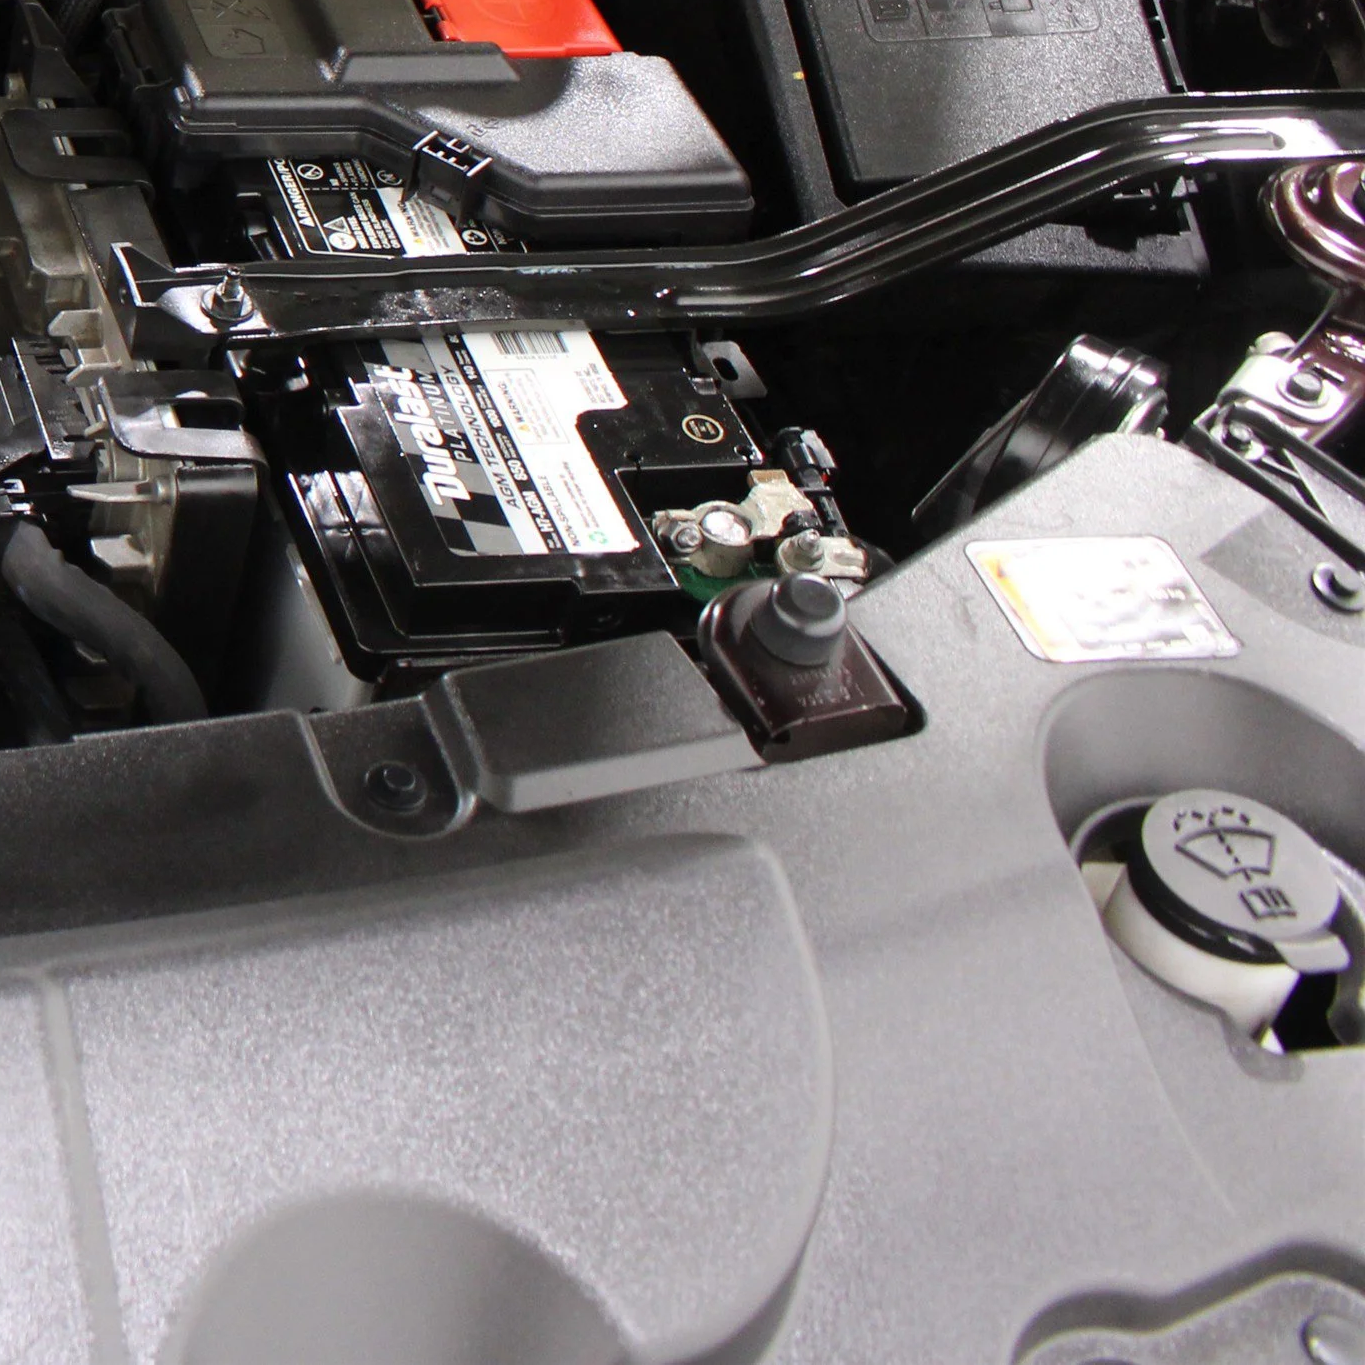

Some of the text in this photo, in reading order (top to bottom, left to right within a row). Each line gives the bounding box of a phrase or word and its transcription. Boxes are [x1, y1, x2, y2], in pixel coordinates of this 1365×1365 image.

[373, 364, 472, 506] Duralast
[415, 369, 474, 463] PLATINUM
[439, 364, 501, 468] TECHNOLOGY
[491, 471, 522, 510] AGM
[506, 458, 529, 481] 850
[521, 490, 555, 533] H7-AGM
[536, 474, 582, 547] NON-SPILLABLE
